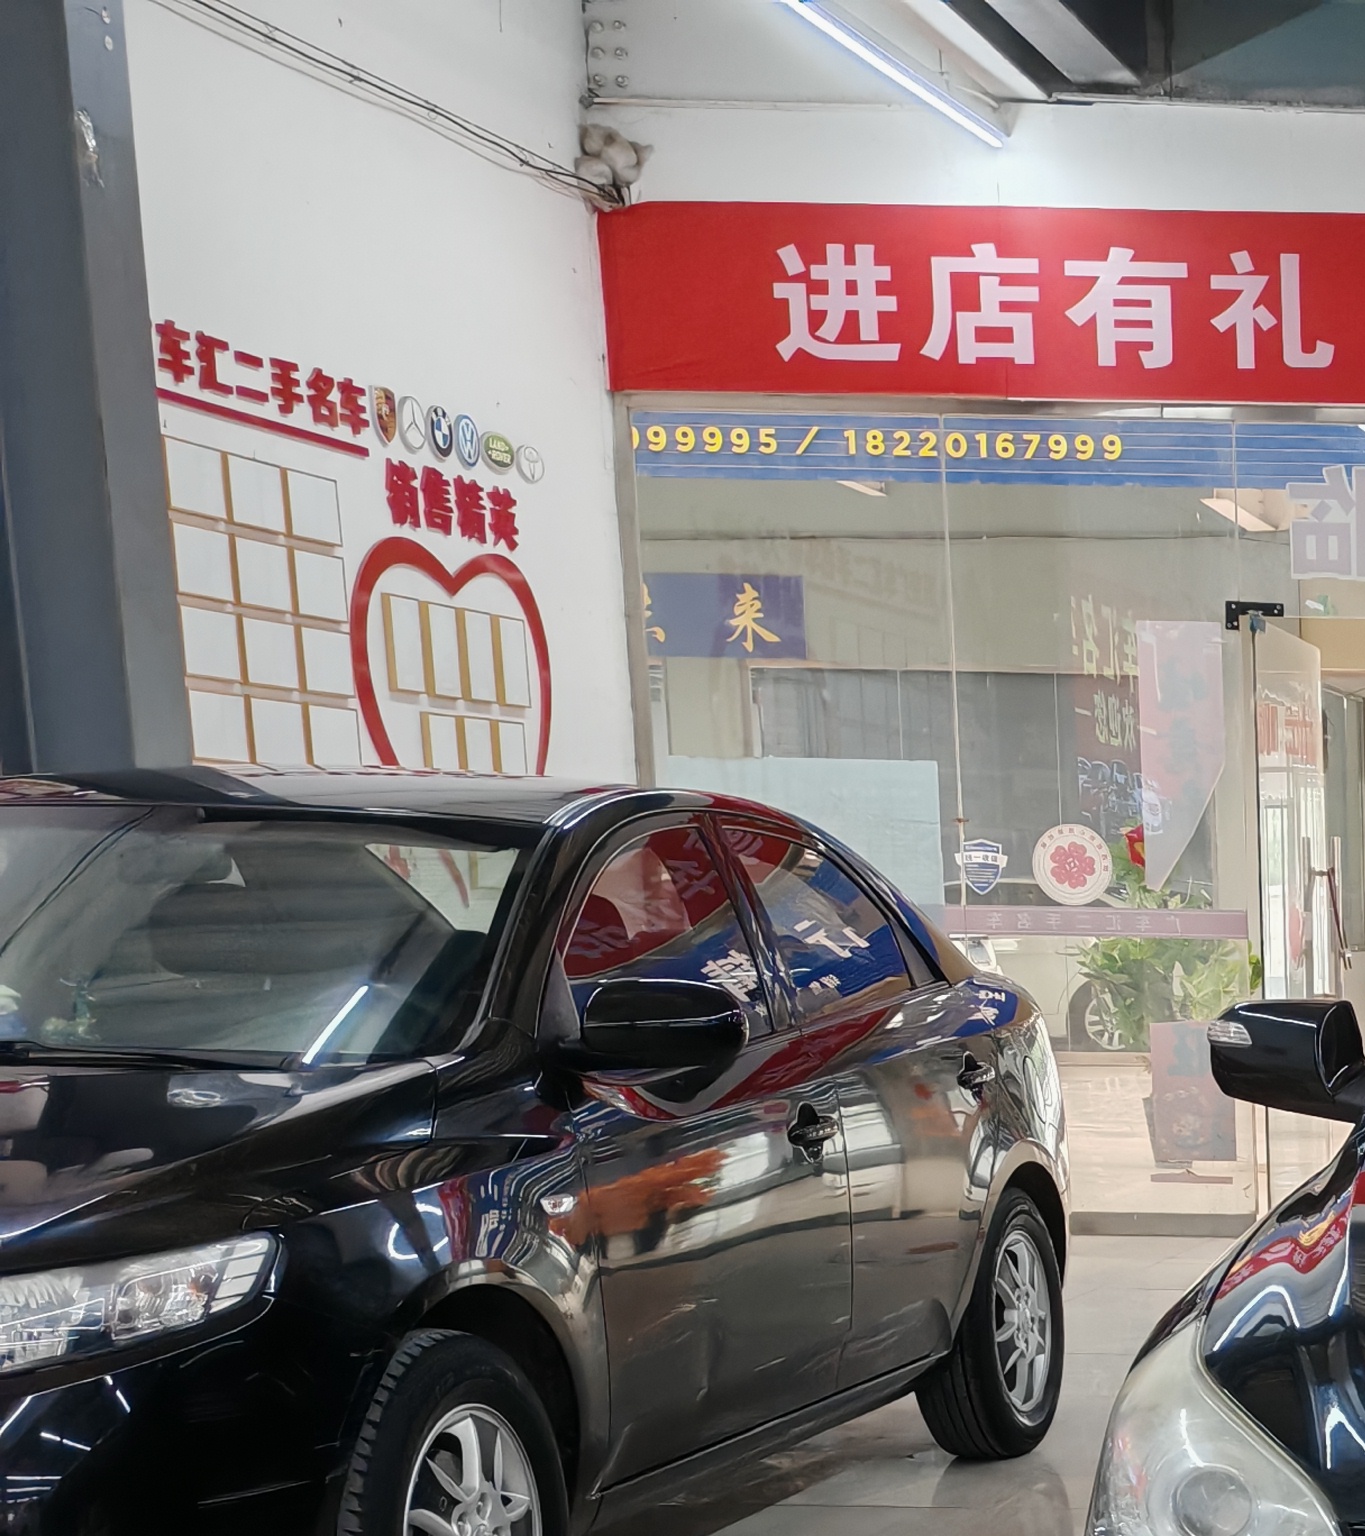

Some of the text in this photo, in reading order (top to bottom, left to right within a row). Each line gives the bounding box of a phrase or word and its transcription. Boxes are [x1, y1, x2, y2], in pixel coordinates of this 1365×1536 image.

[772, 242, 1336, 369] 进店有礼
[155, 318, 371, 437] 车汇二手名车
[844, 429, 1123, 461] 18220167999
[384, 457, 521, 552] 销售精英
